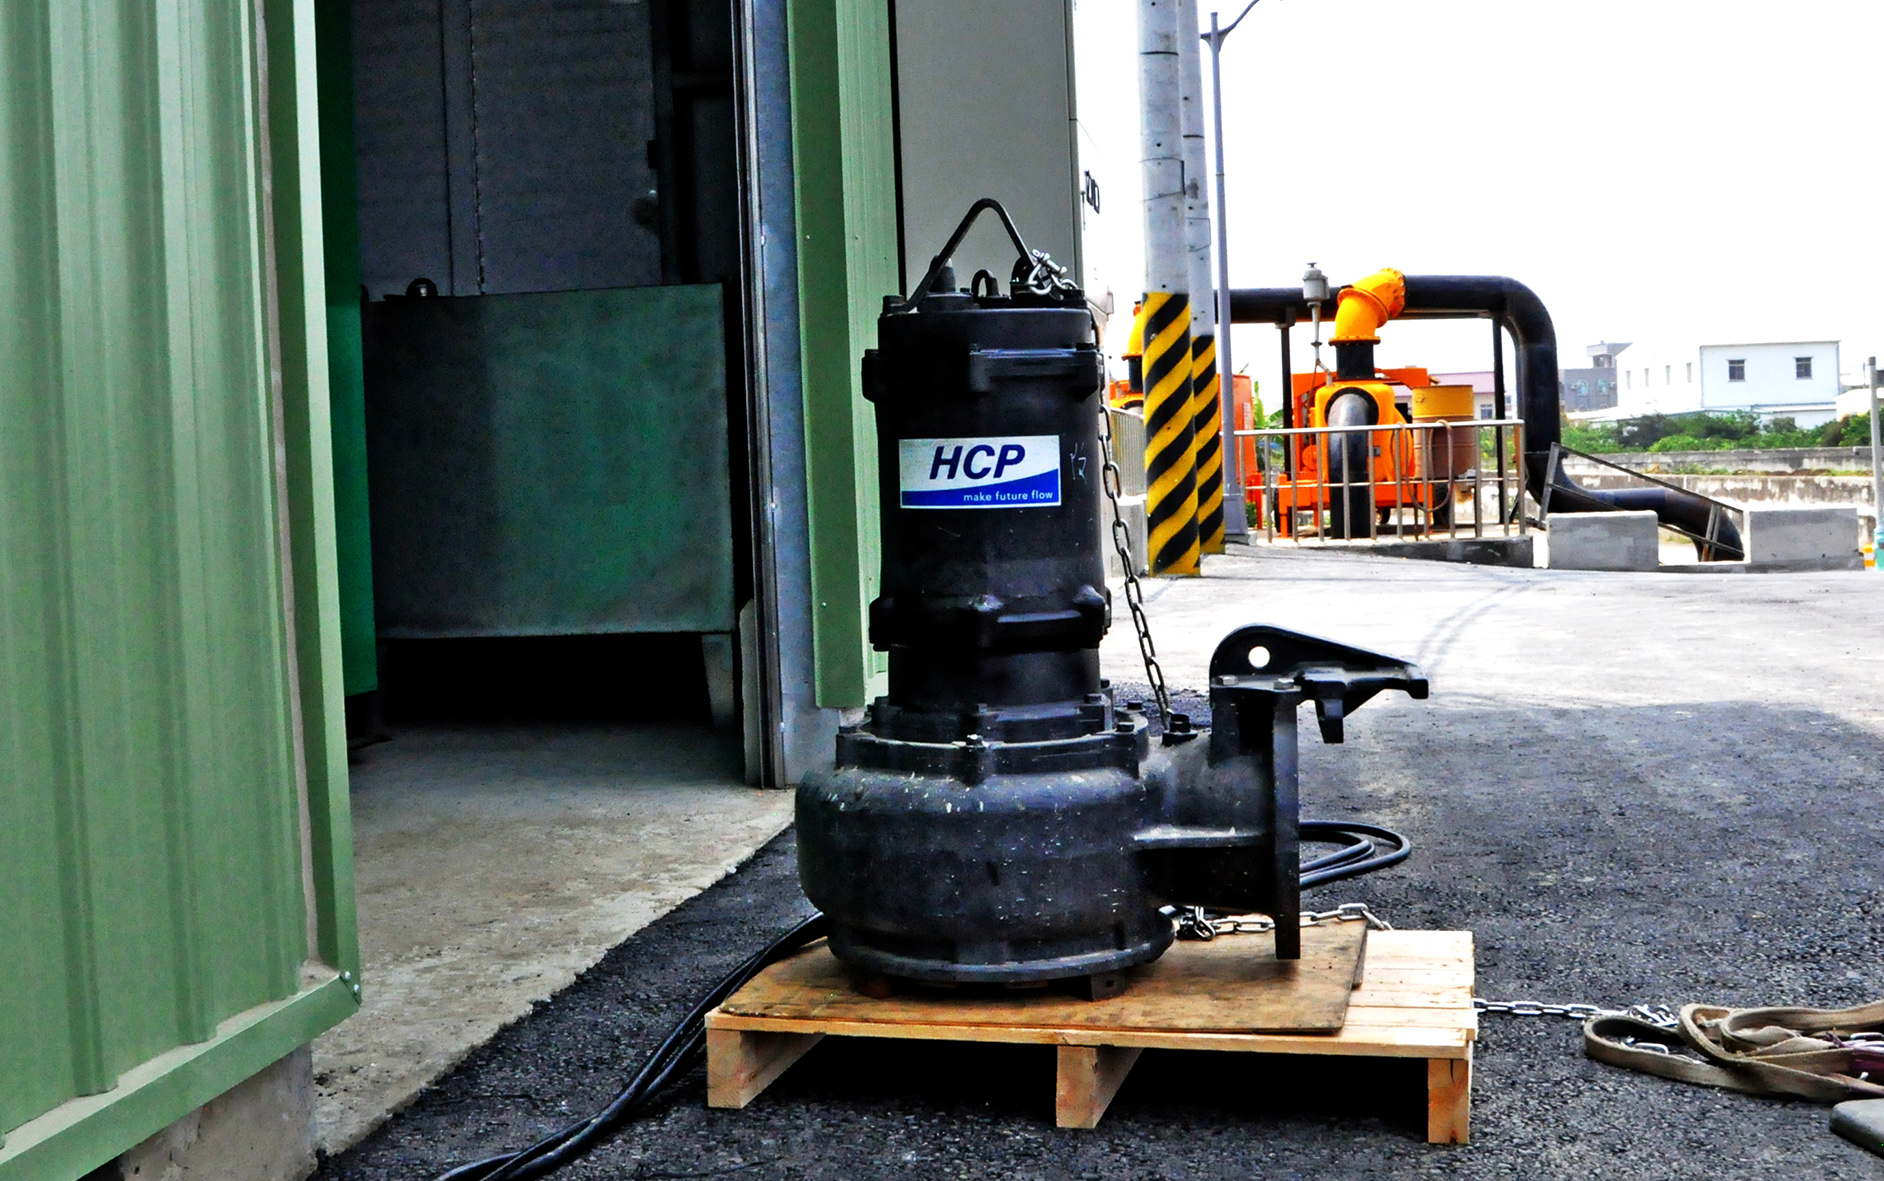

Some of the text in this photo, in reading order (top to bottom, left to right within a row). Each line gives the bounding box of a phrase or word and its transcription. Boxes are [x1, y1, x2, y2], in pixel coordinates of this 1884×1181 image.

[929, 444, 1026, 480] HCP
[963, 489, 1053, 502] make future flow
